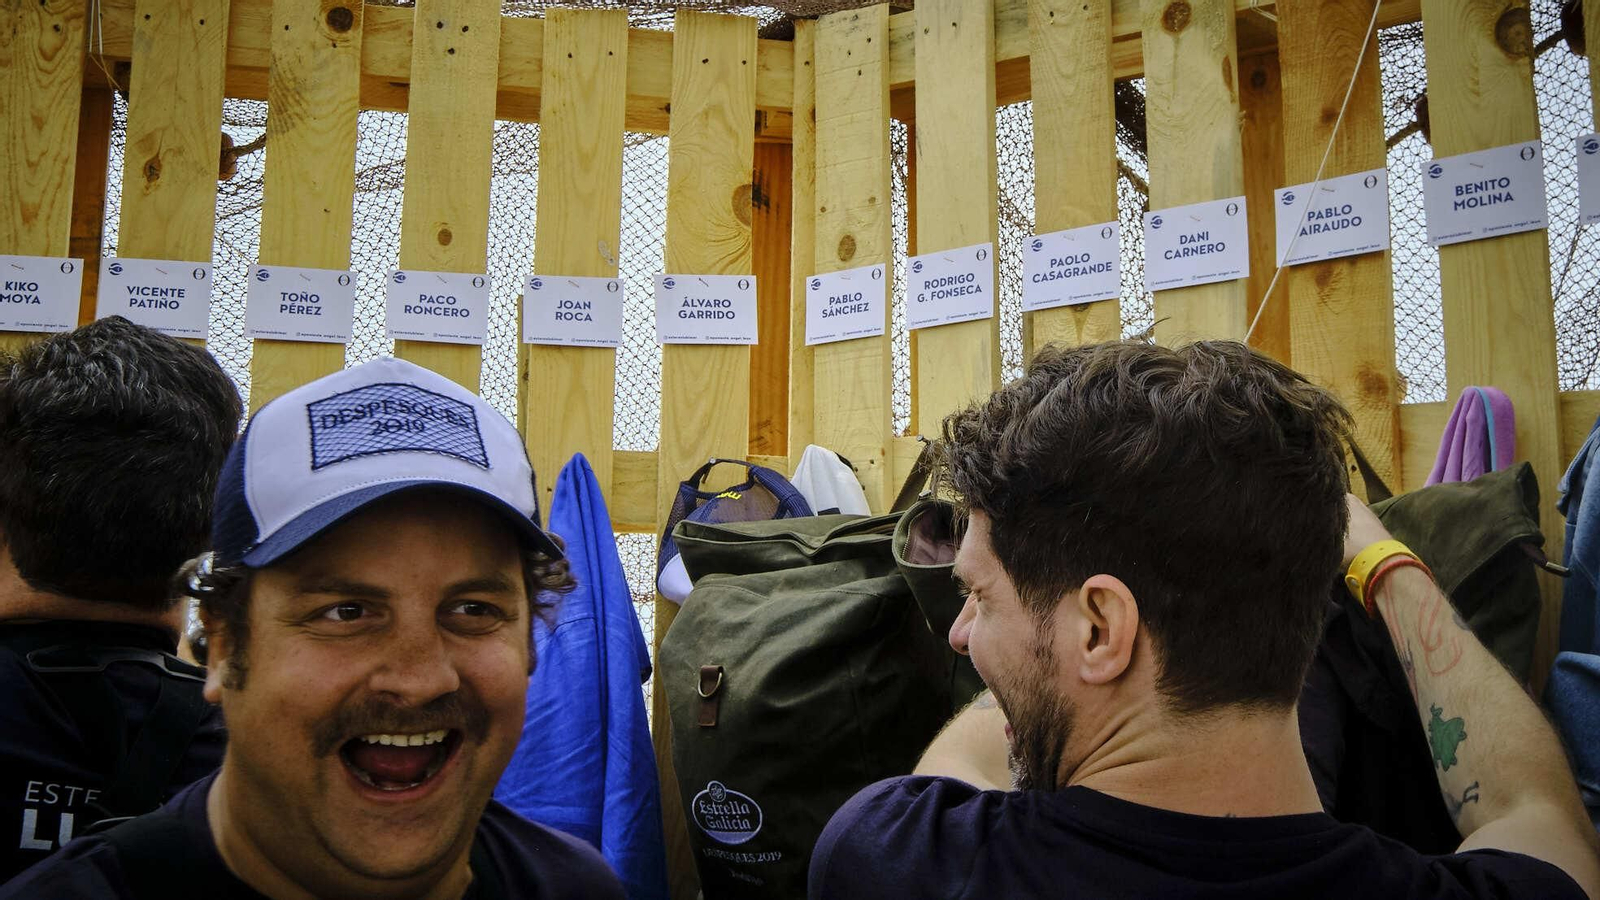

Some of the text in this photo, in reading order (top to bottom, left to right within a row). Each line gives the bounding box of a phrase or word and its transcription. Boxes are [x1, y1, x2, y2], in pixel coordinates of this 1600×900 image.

[1454, 177, 1512, 198] BENITO
[1452, 192, 1515, 211] MOLINA
[1306, 204, 1355, 222] PABLO
[1299, 216, 1363, 237] AIRAUDO
[1179, 231, 1210, 245] DANI
[1163, 242, 1226, 260] CARNERO
[1050, 253, 1091, 268] PAOLO
[1032, 262, 1112, 283] CASAGRANDE
[5, 281, 39, 292] KIKO
[924, 273, 976, 289] RODRIGO
[0, 293, 41, 305] MOYA
[127, 286, 186, 299] VICENTE
[280, 290, 321, 304] TOÑO
[419, 294, 457, 305] PACO
[829, 292, 863, 305] PABLO
[917, 285, 982, 303] G. FONSECA
[129, 297, 180, 310] PATIÑO
[279, 302, 322, 316] PÉREZ
[556, 299, 592, 310] JOAN
[682, 296, 732, 308] ÁLVARO
[404, 304, 470, 318] RONCERO
[555, 311, 593, 322] ROCA
[678, 309, 736, 320] GARRIDO
[822, 303, 870, 318] SÁNCHEZ
[370, 419, 425, 436] 2019
[699, 801, 750, 815] Estrella
[706, 816, 751, 830] Galicia
[758, 852, 782, 862] 2019
